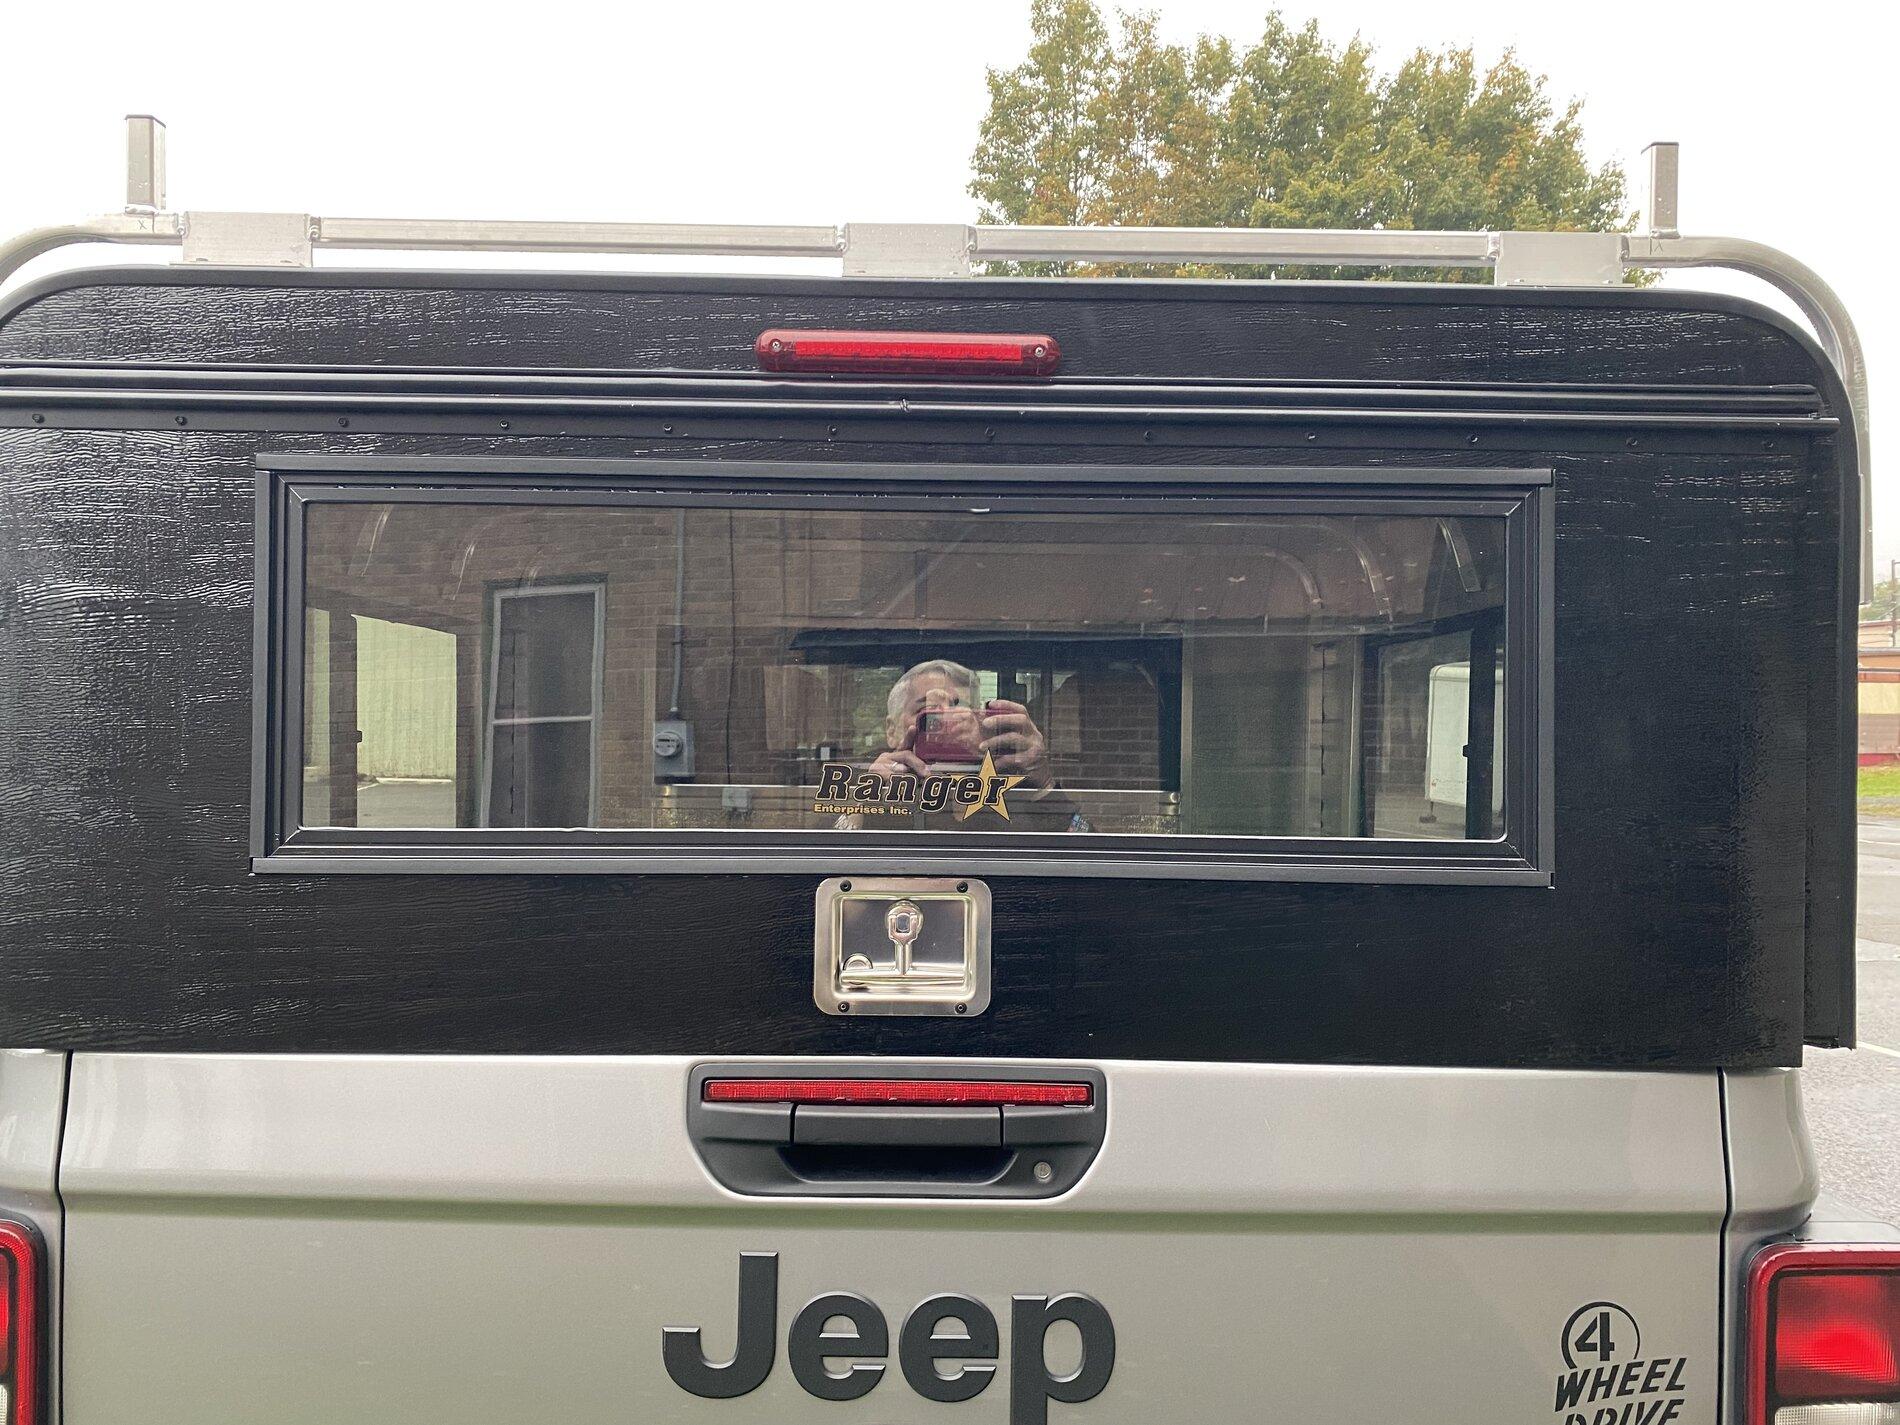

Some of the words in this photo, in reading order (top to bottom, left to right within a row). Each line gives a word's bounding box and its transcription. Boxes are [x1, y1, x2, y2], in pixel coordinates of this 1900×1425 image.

[814, 803, 885, 815] Enterprises
[890, 805, 912, 815] Inc.
[815, 763, 1008, 812] Ranger
[662, 1251, 1116, 1425] Jeep
[1574, 1312, 1615, 1362] 4
[1554, 1357, 1687, 1412] WHEEL
